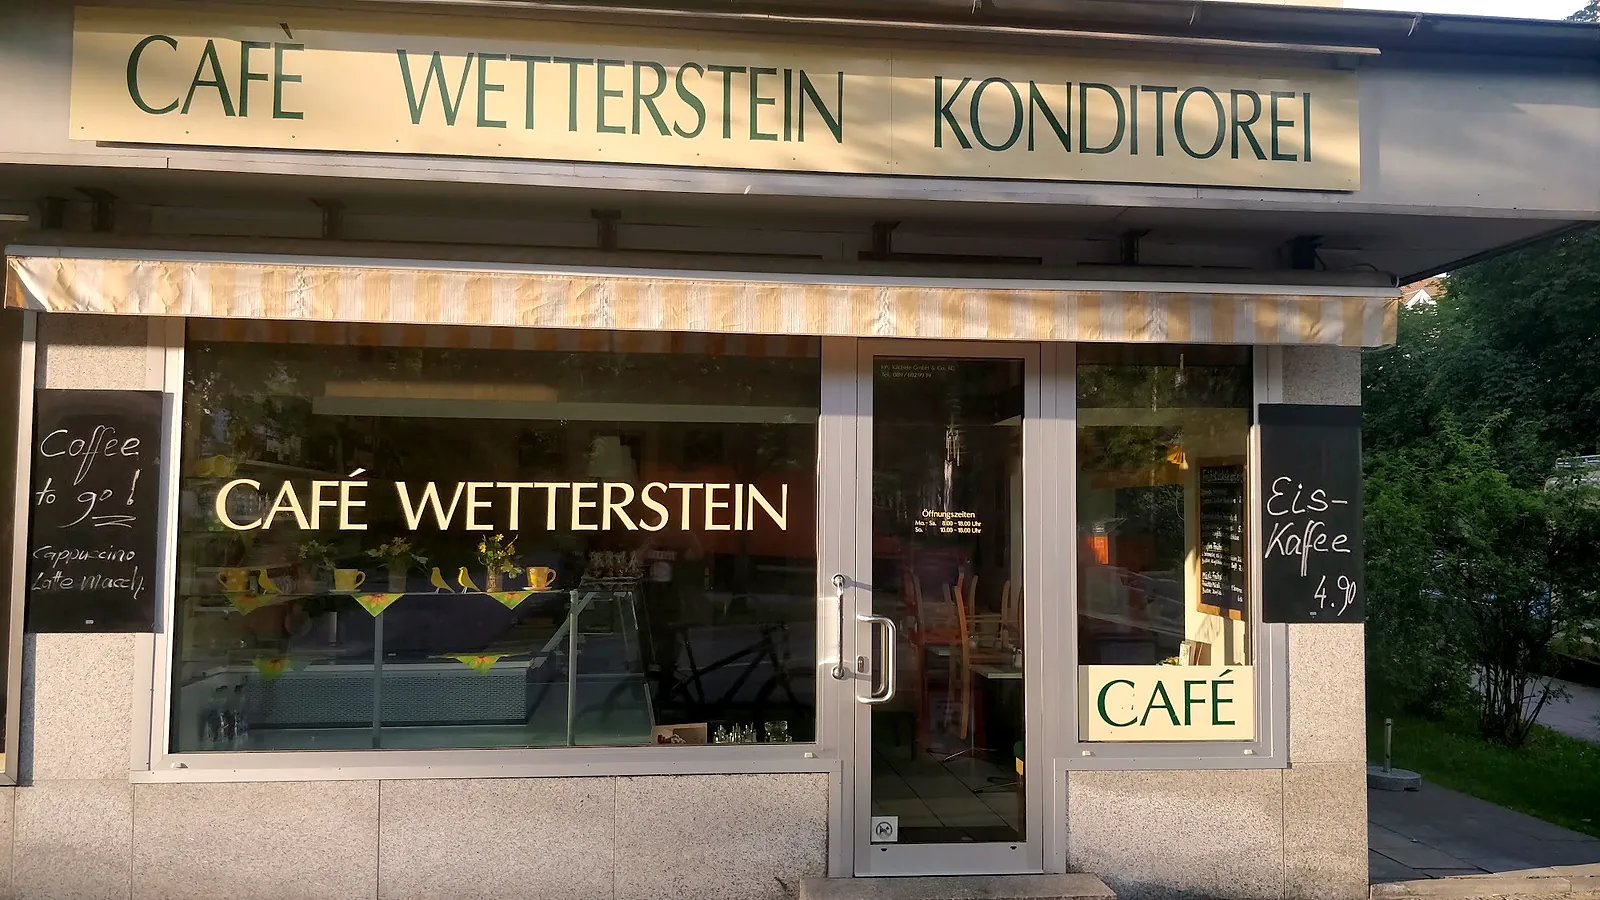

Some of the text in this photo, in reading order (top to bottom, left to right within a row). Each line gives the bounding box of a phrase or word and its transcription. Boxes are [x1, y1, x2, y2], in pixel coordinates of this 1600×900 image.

[126, 22, 1312, 163] CAFÈ WETTERSTEIN KONDITOREI
[40, 425, 140, 486] Coffee
[36, 477, 56, 506] to
[215, 467, 788, 531] CAFÉ WETTERSTEIN
[1266, 476, 1348, 516] Eis-
[922, 509, 976, 519] Öffnungszeiten
[32, 545, 136, 568] Cappuccino
[1265, 519, 1351, 577] Kaffee
[31, 571, 74, 591] Latte
[1313, 575, 1357, 617] 4.90
[1097, 668, 1236, 727] CAFÉ
